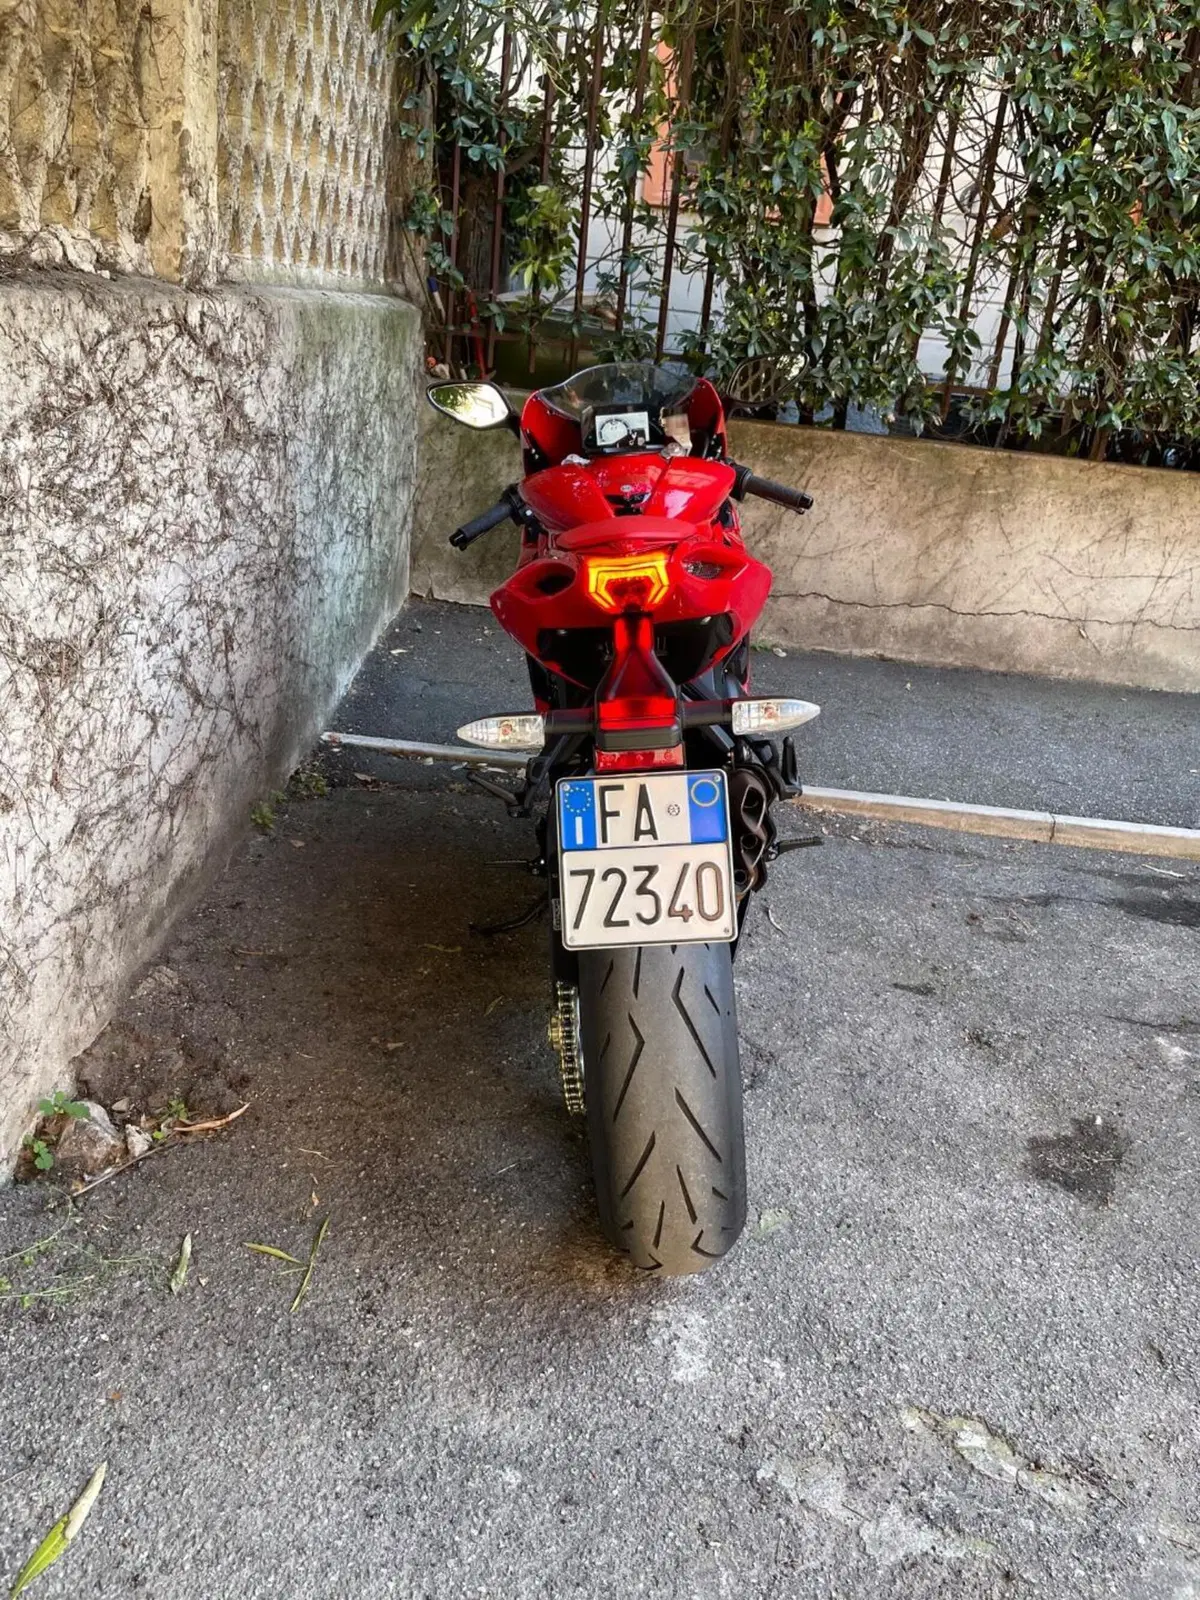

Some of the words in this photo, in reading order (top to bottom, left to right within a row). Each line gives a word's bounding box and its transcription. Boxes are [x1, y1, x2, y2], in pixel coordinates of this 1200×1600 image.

[575, 816, 583, 845] I
[598, 783, 659, 844] FA
[569, 861, 724, 930] 72340
